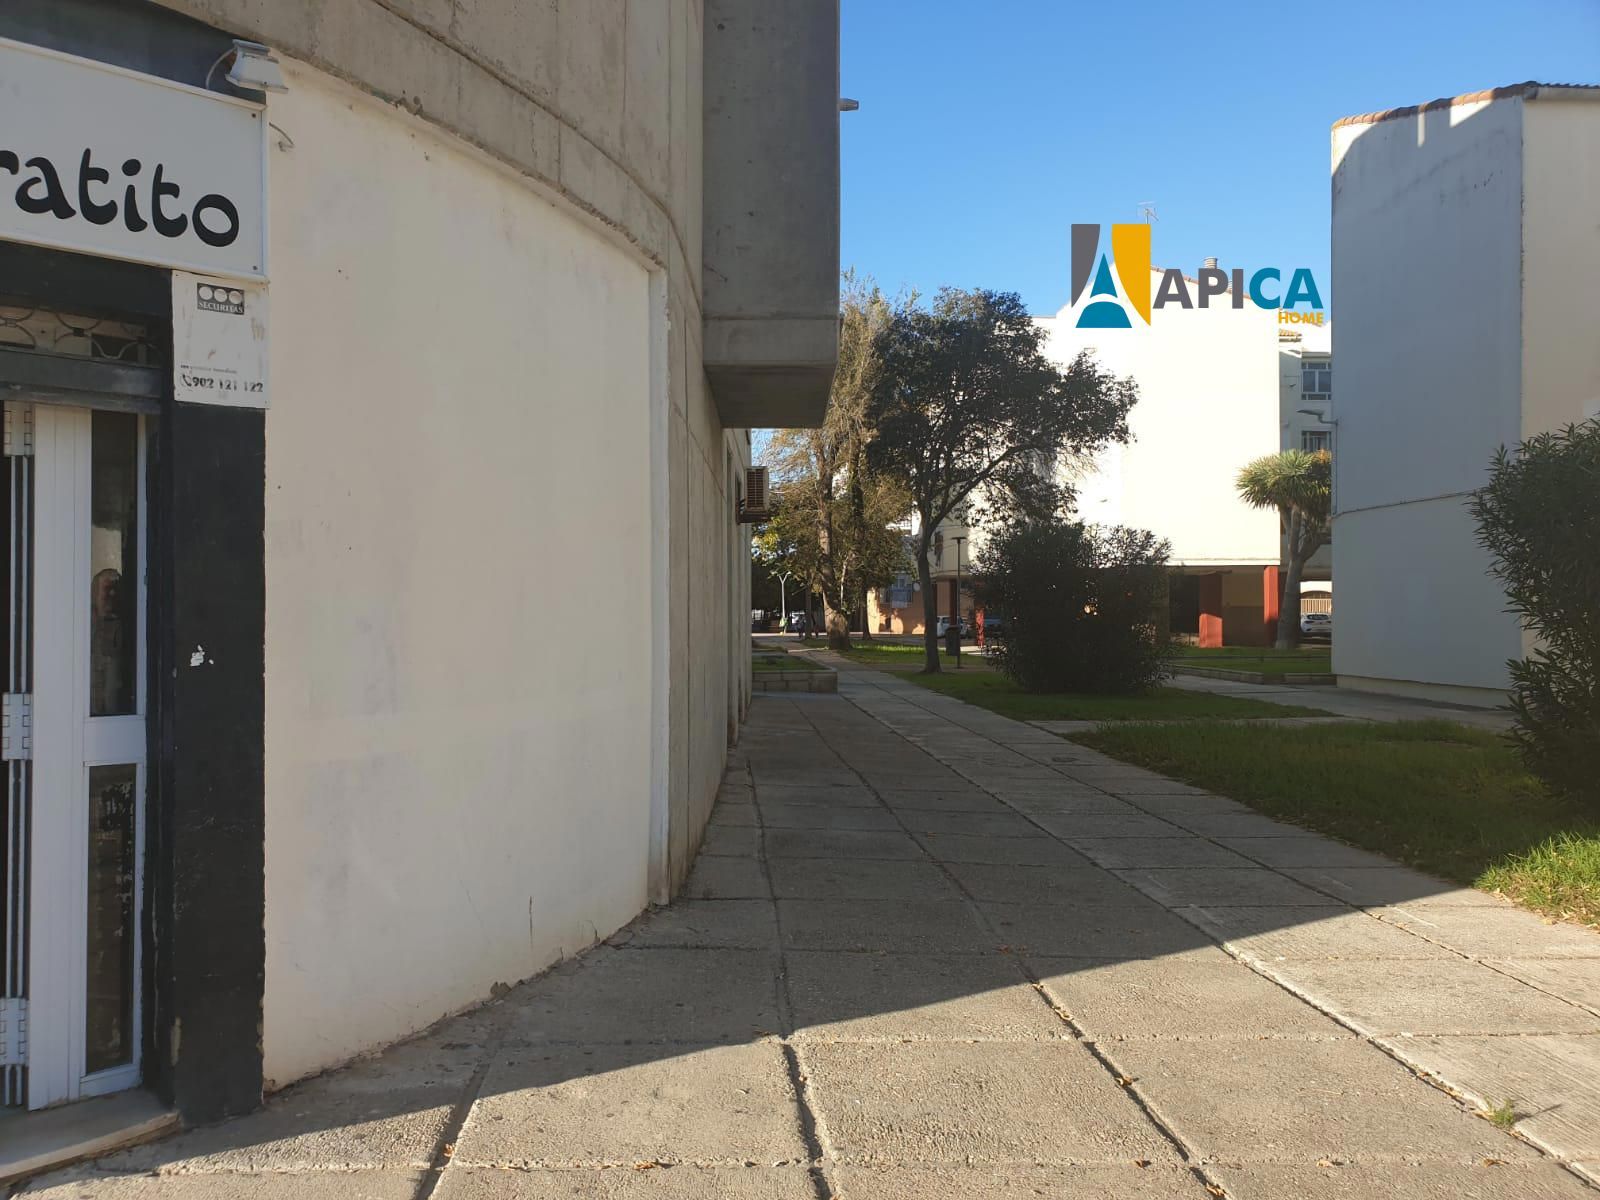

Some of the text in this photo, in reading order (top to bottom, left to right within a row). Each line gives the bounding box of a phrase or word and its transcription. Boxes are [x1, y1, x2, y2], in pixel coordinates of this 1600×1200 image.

[198, 301, 243, 314] SECURITAS
[192, 376, 263, 392] 902 121 122
